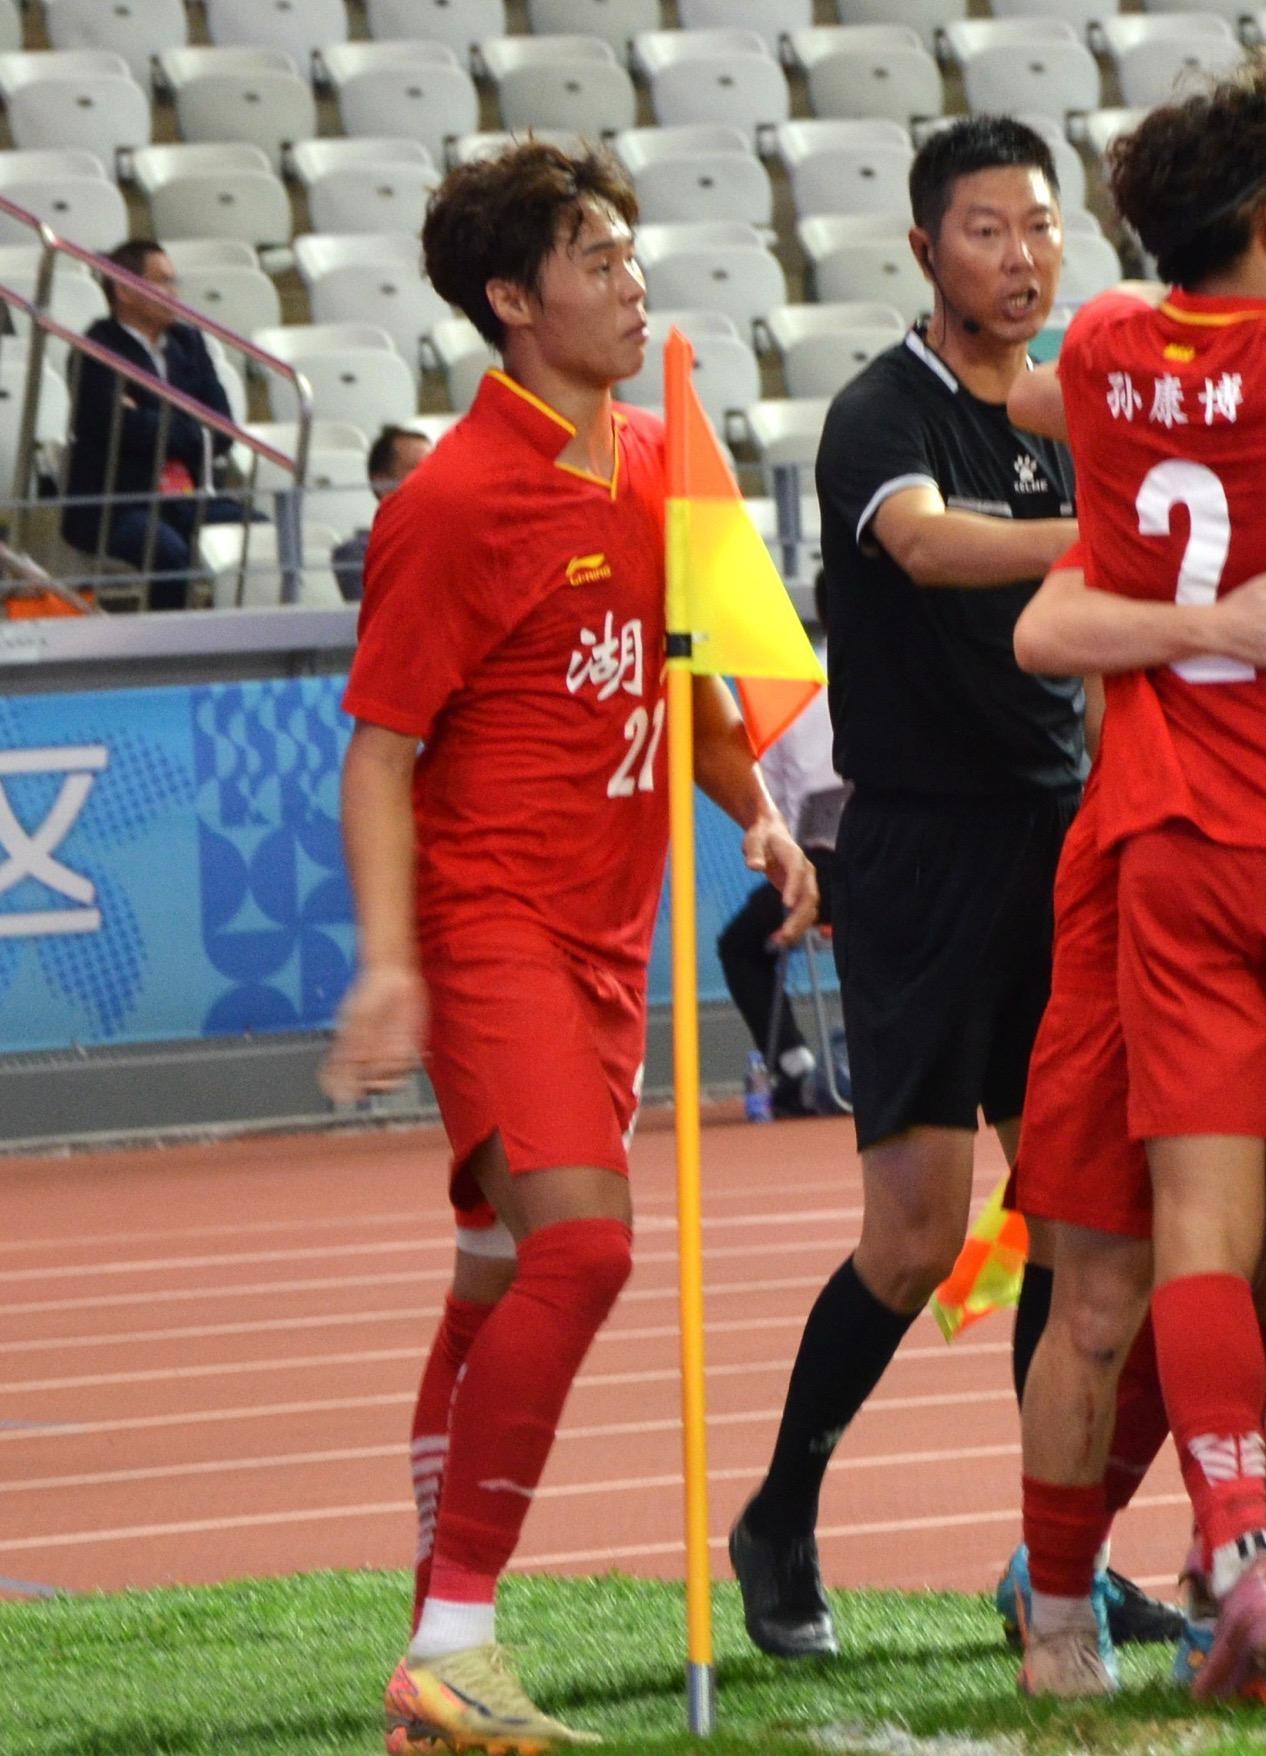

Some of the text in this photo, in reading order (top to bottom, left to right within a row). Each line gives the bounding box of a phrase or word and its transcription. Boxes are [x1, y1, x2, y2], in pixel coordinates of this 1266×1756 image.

[1106, 371, 1244, 429] 孙康博
[1135, 458, 1257, 685] 2
[566, 609, 668, 701] 湖
[606, 698, 665, 798] 21
